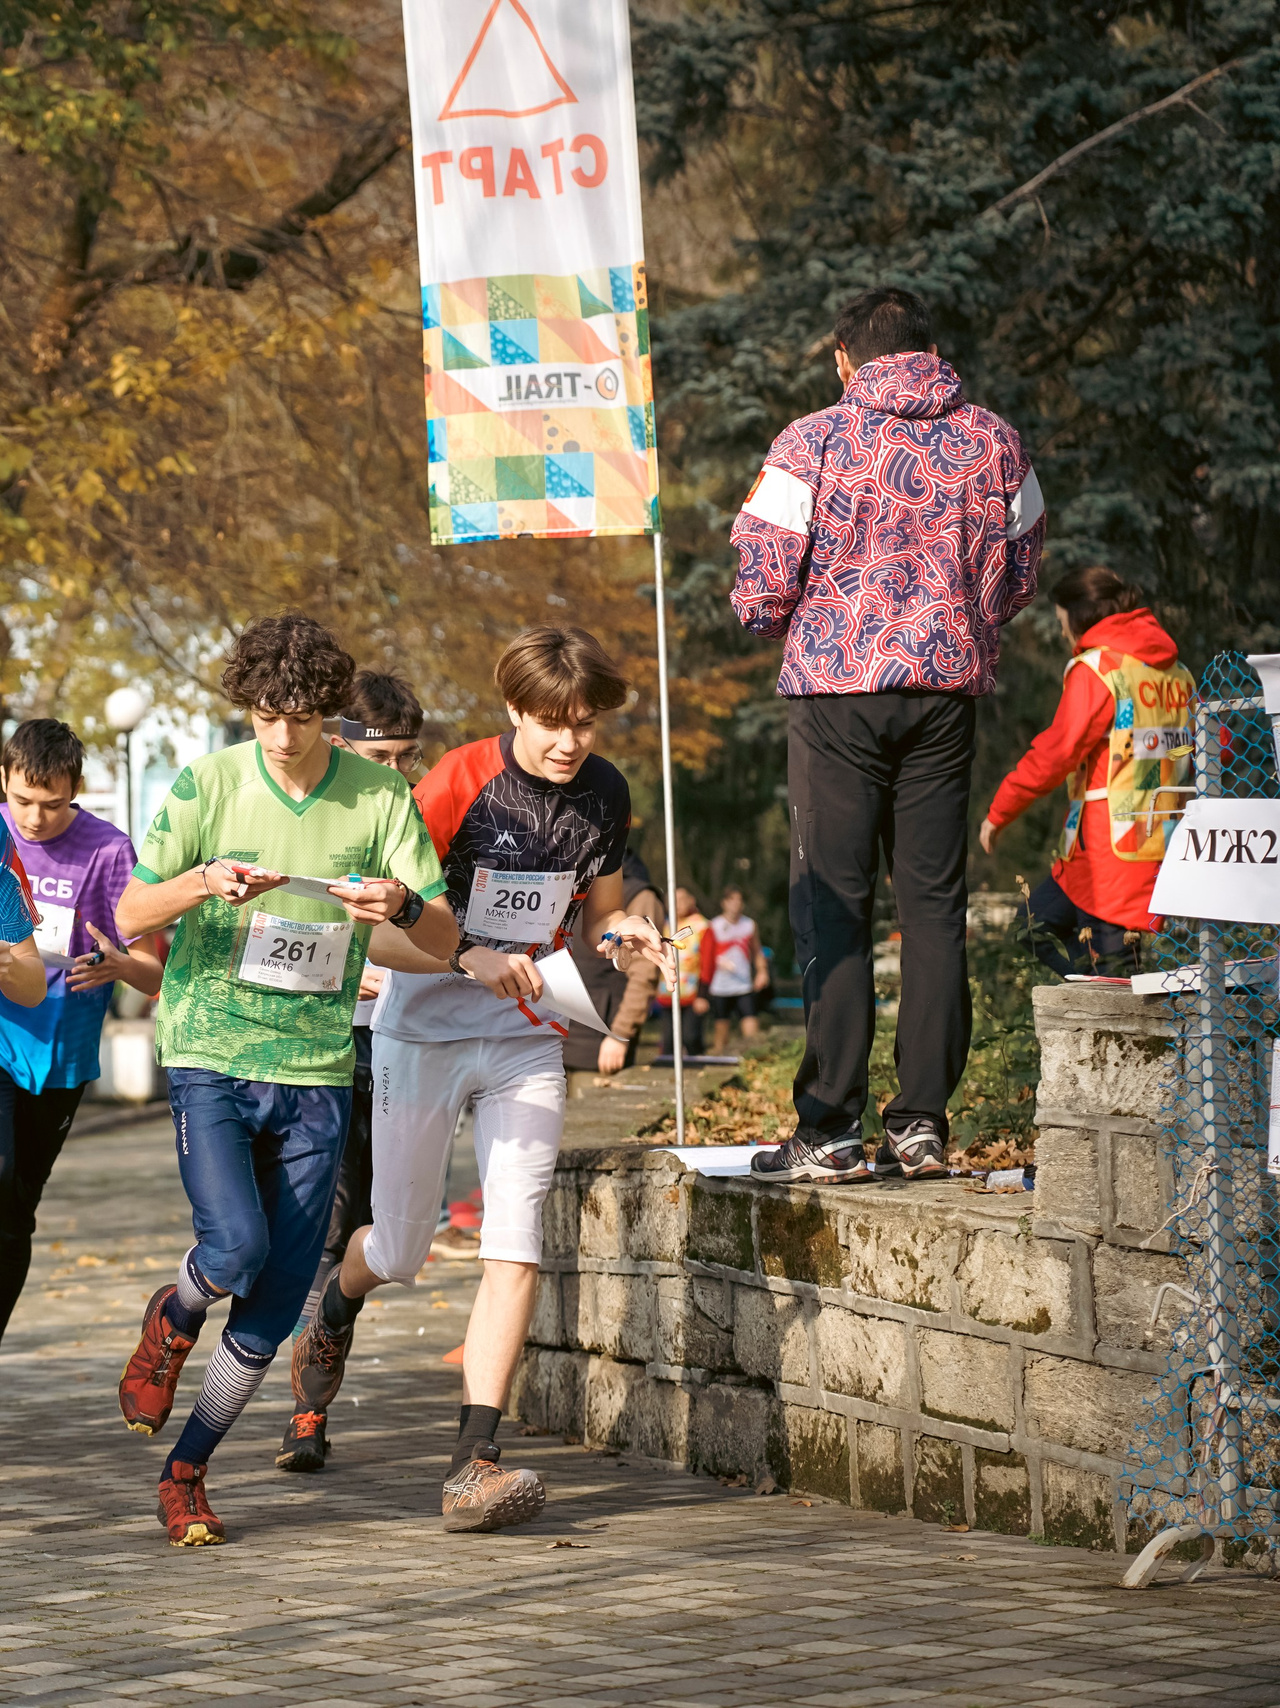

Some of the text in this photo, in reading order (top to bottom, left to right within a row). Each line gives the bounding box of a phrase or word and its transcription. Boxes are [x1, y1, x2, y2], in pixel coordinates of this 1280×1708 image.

[1179, 828, 1279, 864] МЖ2
[476, 869, 489, 888] ЭТАП
[491, 872, 525, 881] ПЕРВЕНСТВО
[26, 874, 73, 899] ПСБ
[493, 889, 542, 912] 260
[550, 901, 556, 915] 1
[485, 908, 518, 920] МЖ16
[253, 913, 268, 935] ЭТАП
[270, 917, 305, 931] ПЕРВЕНСТВО
[269, 937, 317, 962] 261
[261, 958, 294, 972] МЖ16
[325, 952, 331, 965] 1
